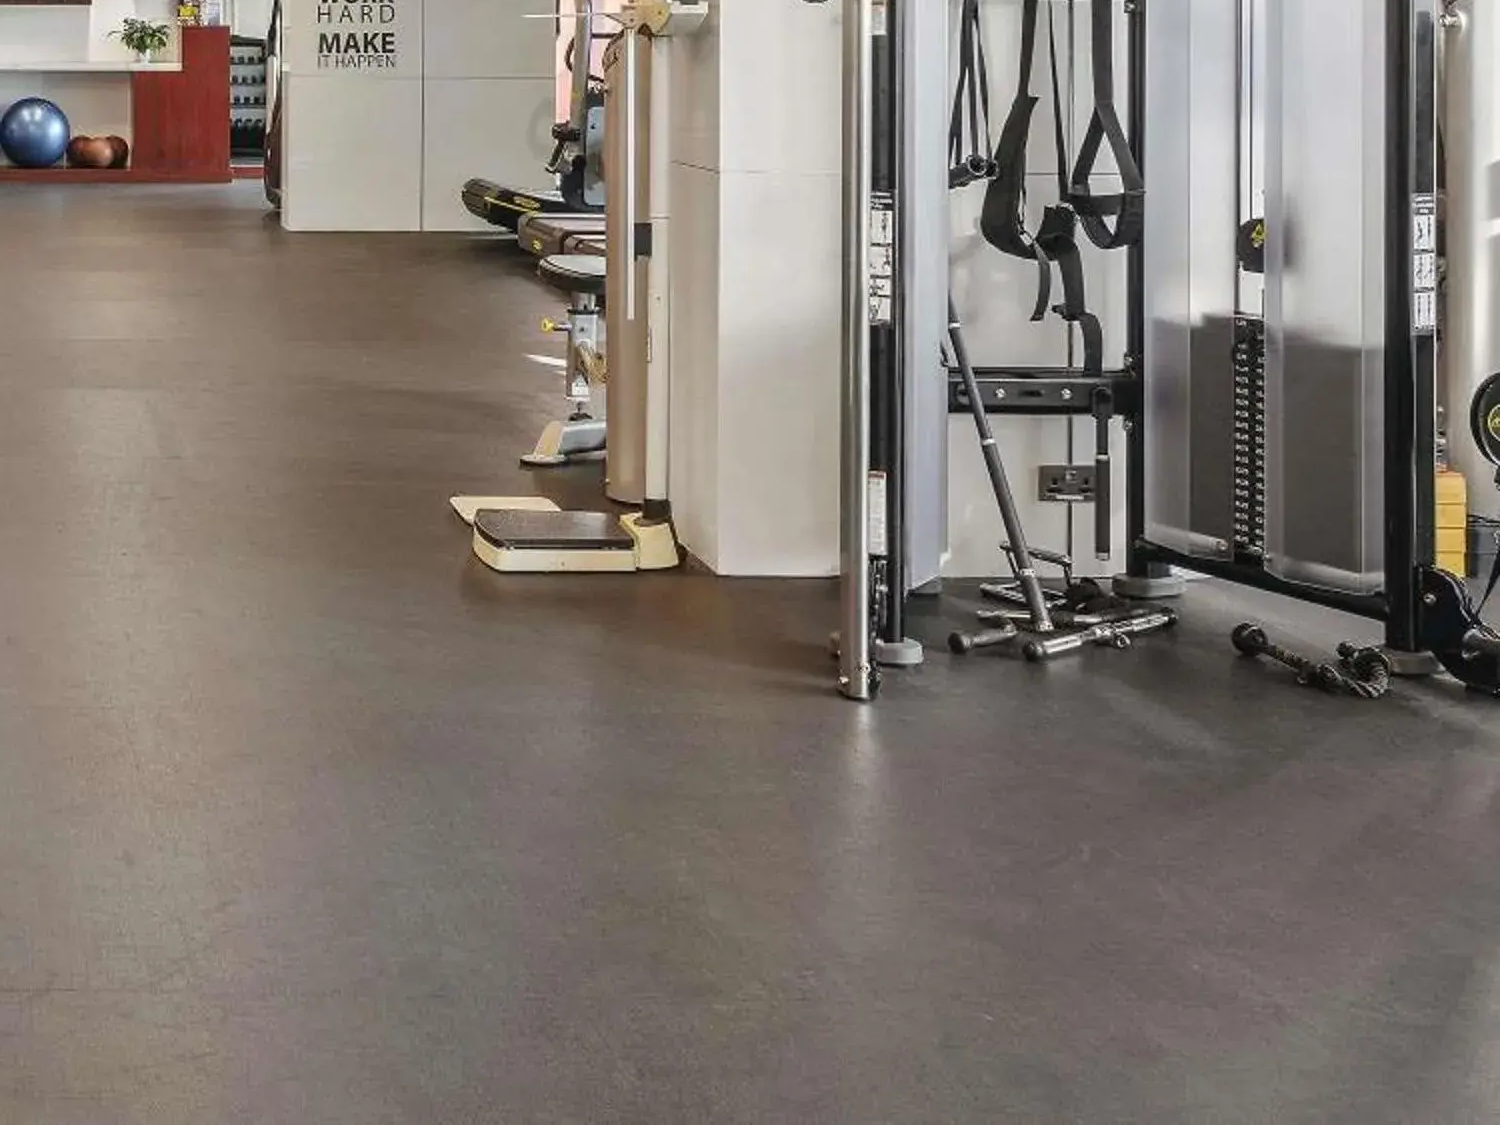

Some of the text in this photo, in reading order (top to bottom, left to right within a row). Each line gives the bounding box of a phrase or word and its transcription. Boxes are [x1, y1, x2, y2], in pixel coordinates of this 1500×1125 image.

[317, 5, 396, 24] HARD
[318, 32, 396, 54] MAKE
[317, 54, 397, 69] IT HAPPEN
